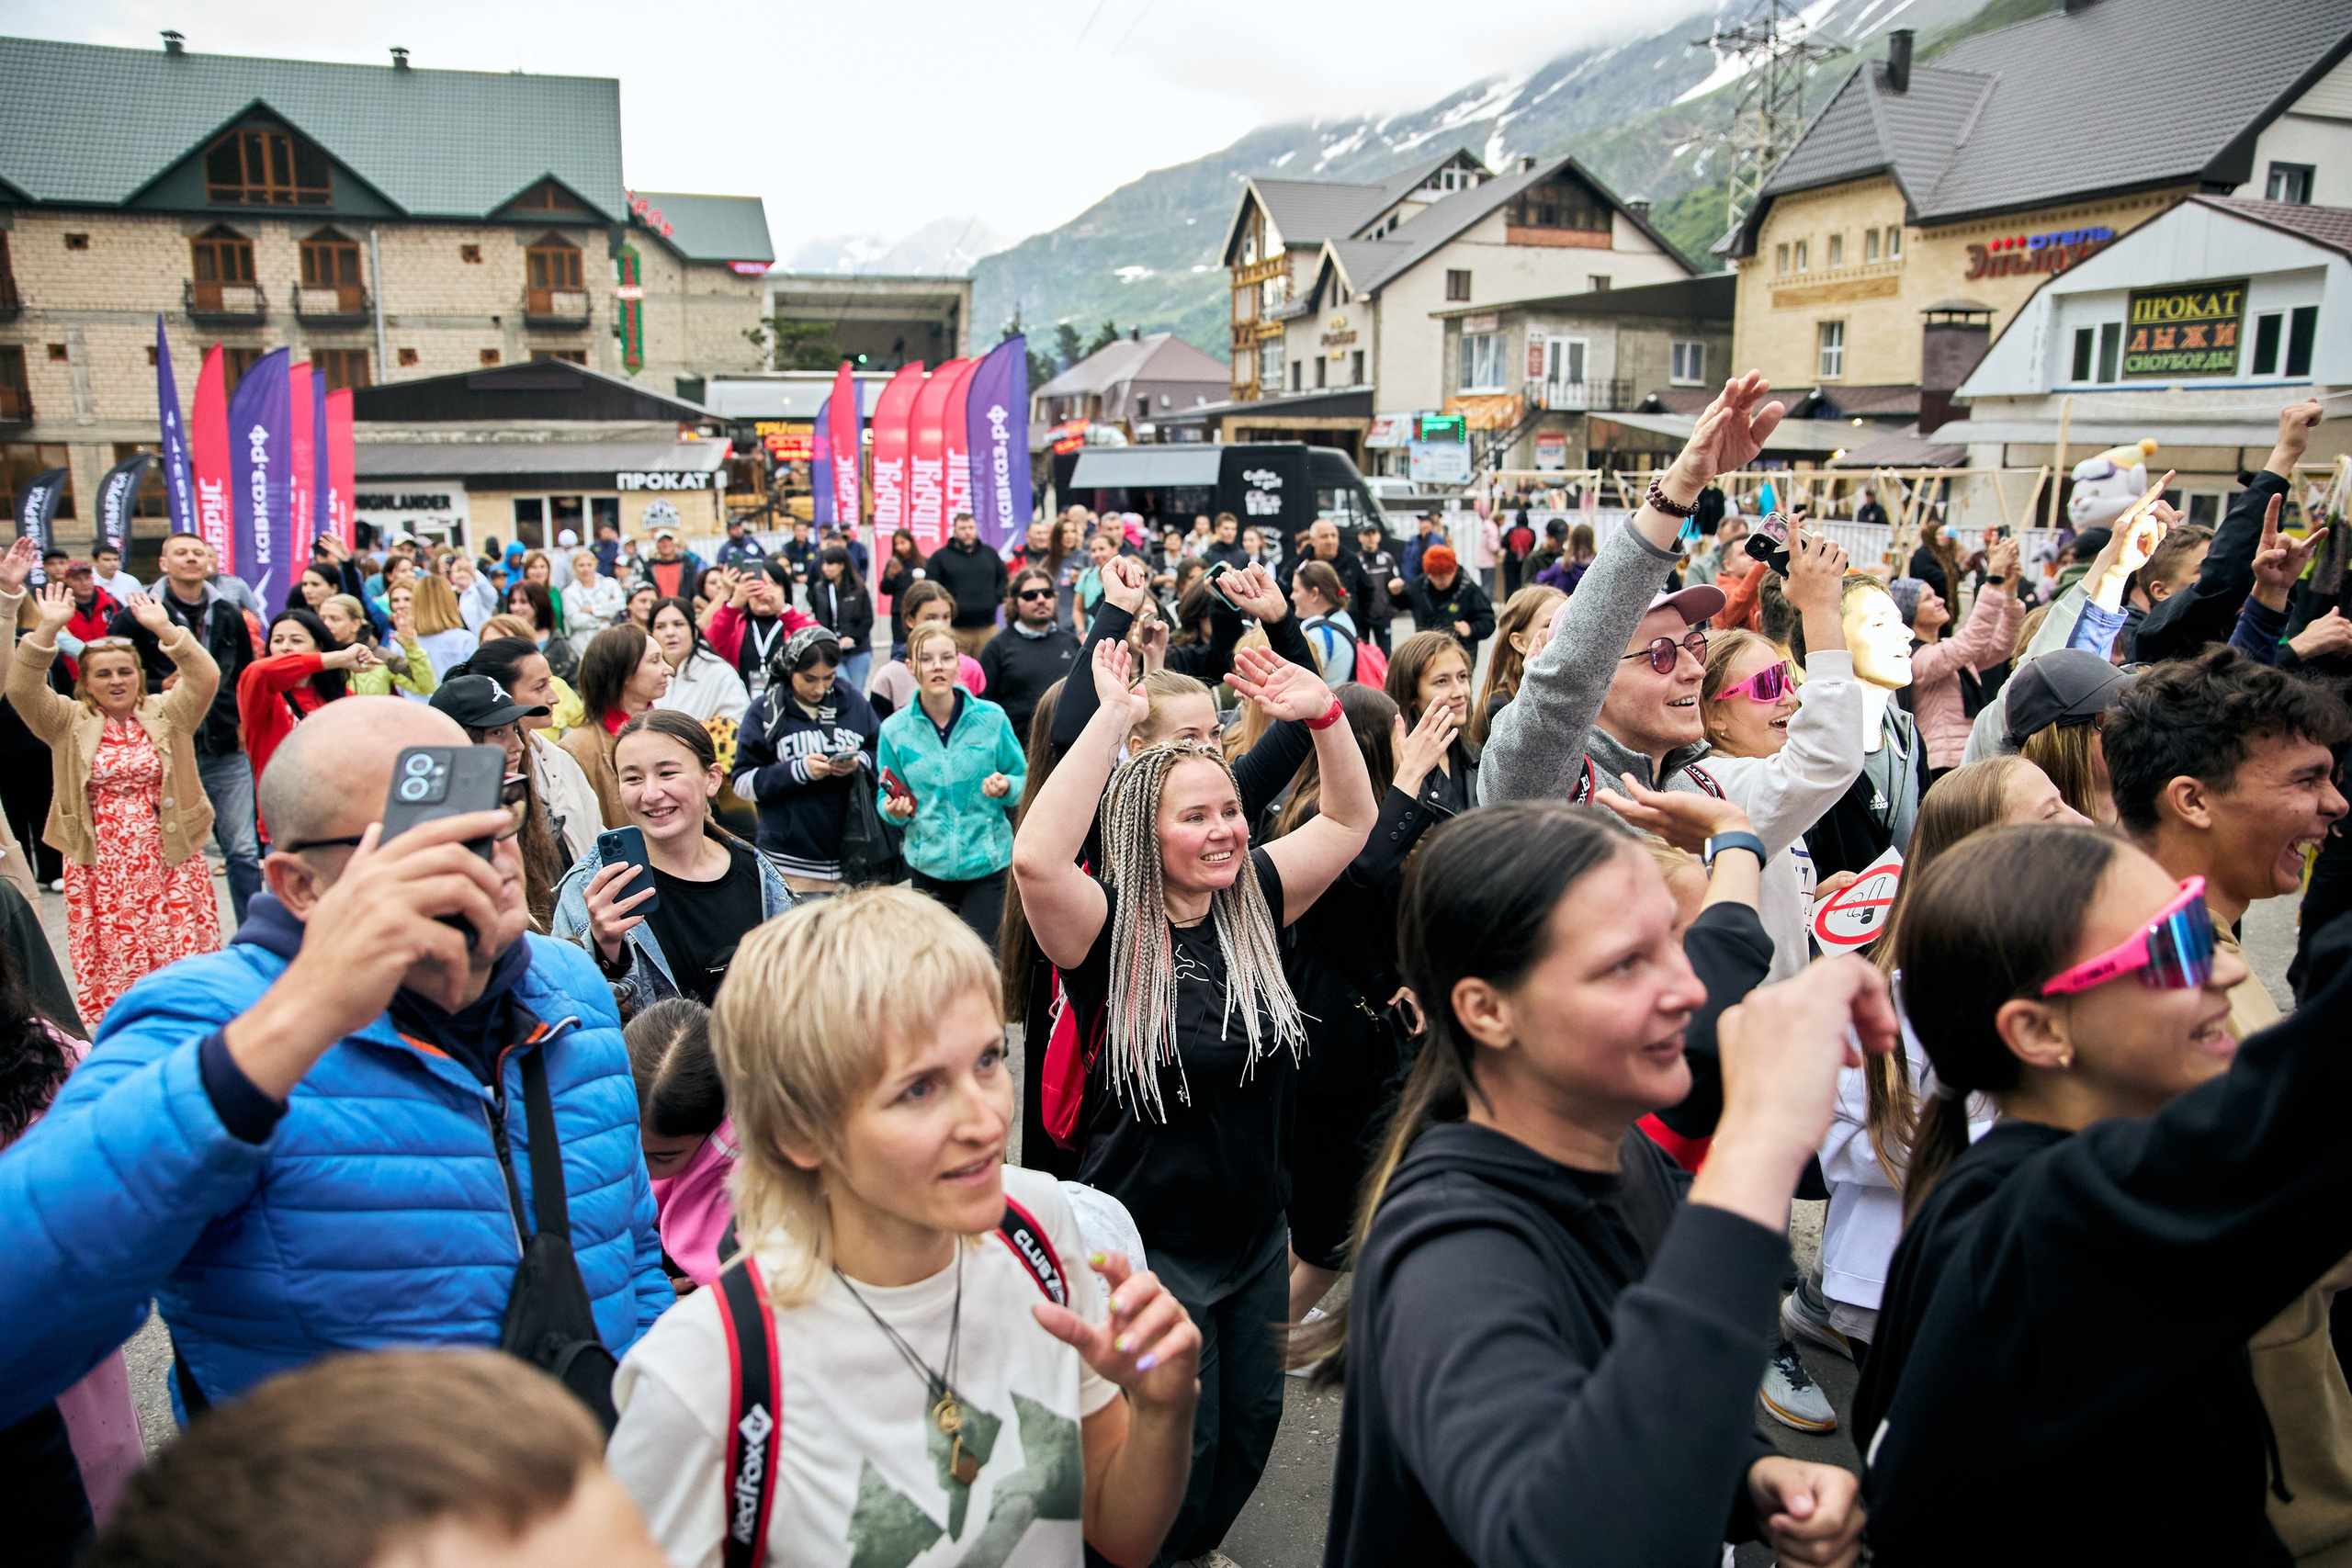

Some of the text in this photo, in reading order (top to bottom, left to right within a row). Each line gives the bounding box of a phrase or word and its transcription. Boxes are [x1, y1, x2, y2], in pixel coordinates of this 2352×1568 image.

[2029, 227, 2113, 250] ОТЕЛЬ
[2132, 289, 2241, 322] ПРОКАТ
[2124, 350, 2235, 373] СНОУБОРДЫ
[616, 471, 711, 491] ПРОКАТ
[987, 403, 1015, 529] кавказ.рф
[248, 424, 271, 564] кавказ.рф
[911, 455, 943, 544] ЭЛЬБРУС
